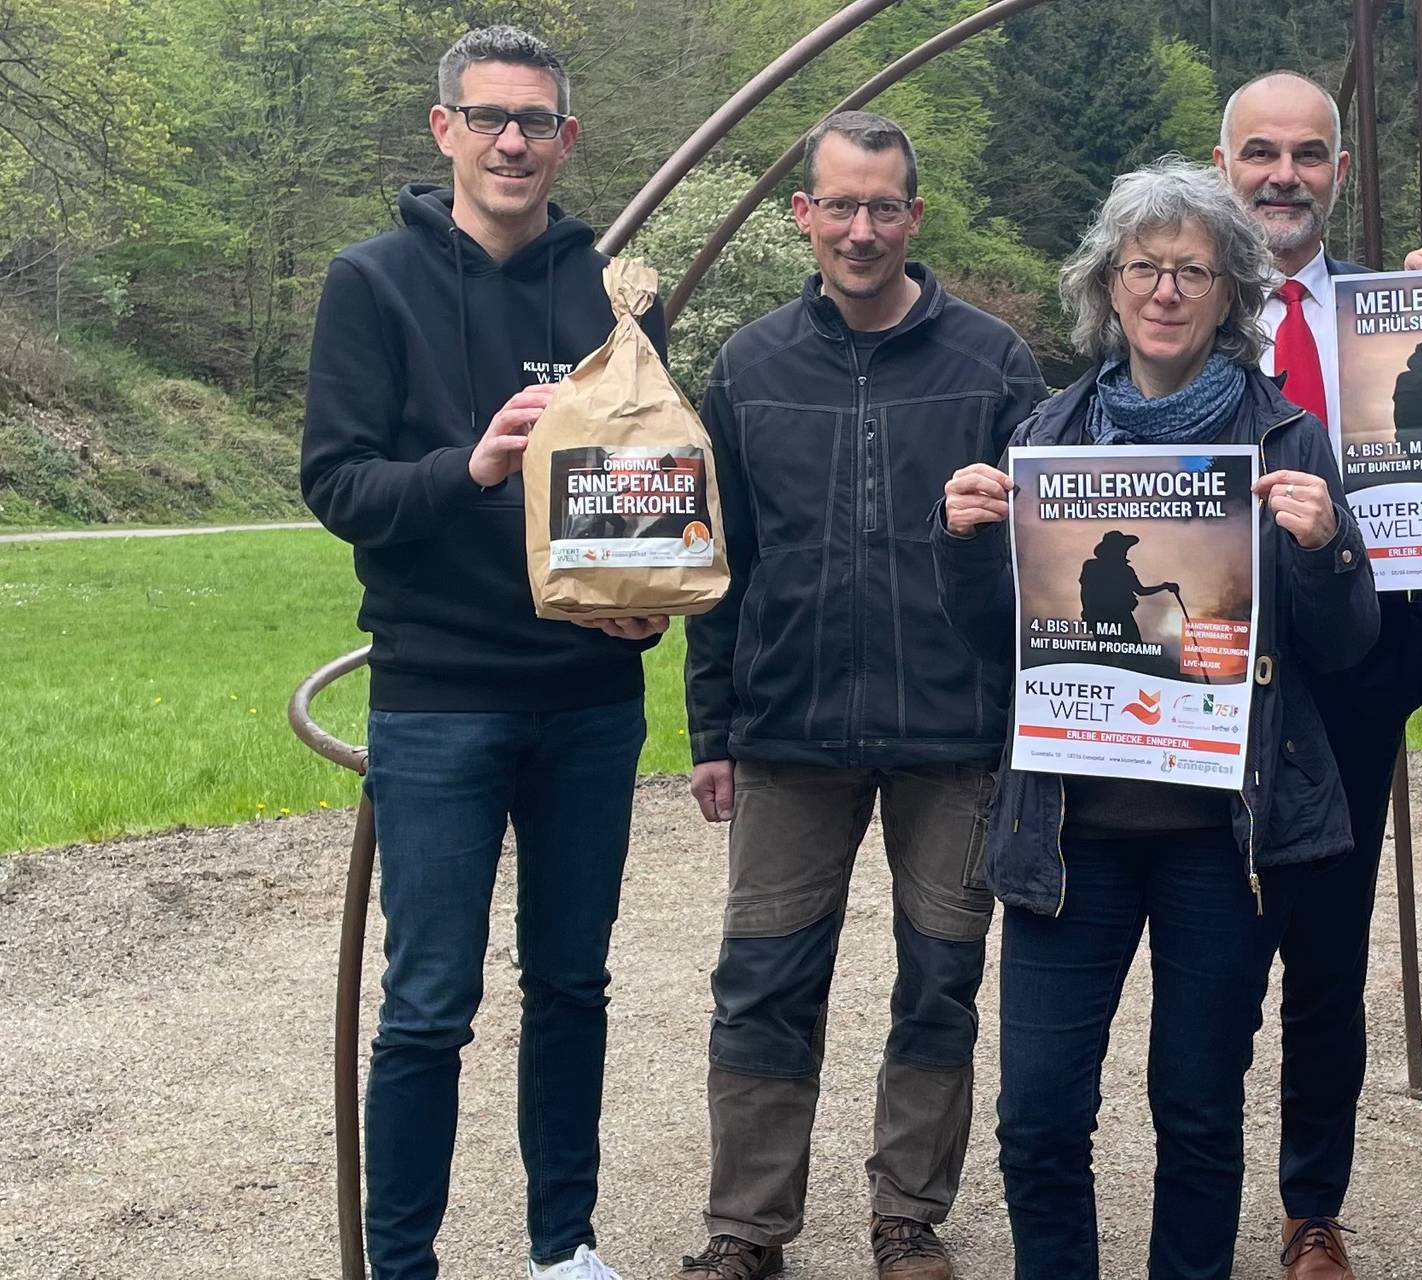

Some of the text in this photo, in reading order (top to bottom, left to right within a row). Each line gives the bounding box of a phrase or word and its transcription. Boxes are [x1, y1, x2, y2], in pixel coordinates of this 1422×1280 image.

[1357, 319, 1375, 334] IM
[1346, 445, 1359, 457] 4.
[1362, 443, 1384, 457] BIS
[1386, 442, 1408, 456] 11.
[603, 458, 661, 472] ORIGINAL
[1347, 462, 1366, 475] MIT
[1368, 459, 1411, 473] BUNTEM
[567, 474, 695, 495] ENNEPETALER
[1039, 471, 1226, 499] MEILERWOCHE
[567, 495, 696, 516] MEILERKOHLE
[1040, 499, 1226, 519] IM HÜLSENBECKER TAL
[1030, 619, 1121, 637] 4. BIS 11. MAI
[1233, 625, 1248, 633] UND
[1030, 638, 1161, 655] MIT BUNTEM PROGRAMM
[1025, 680, 1115, 699] KLUTERT
[1049, 699, 1115, 722] WELT
